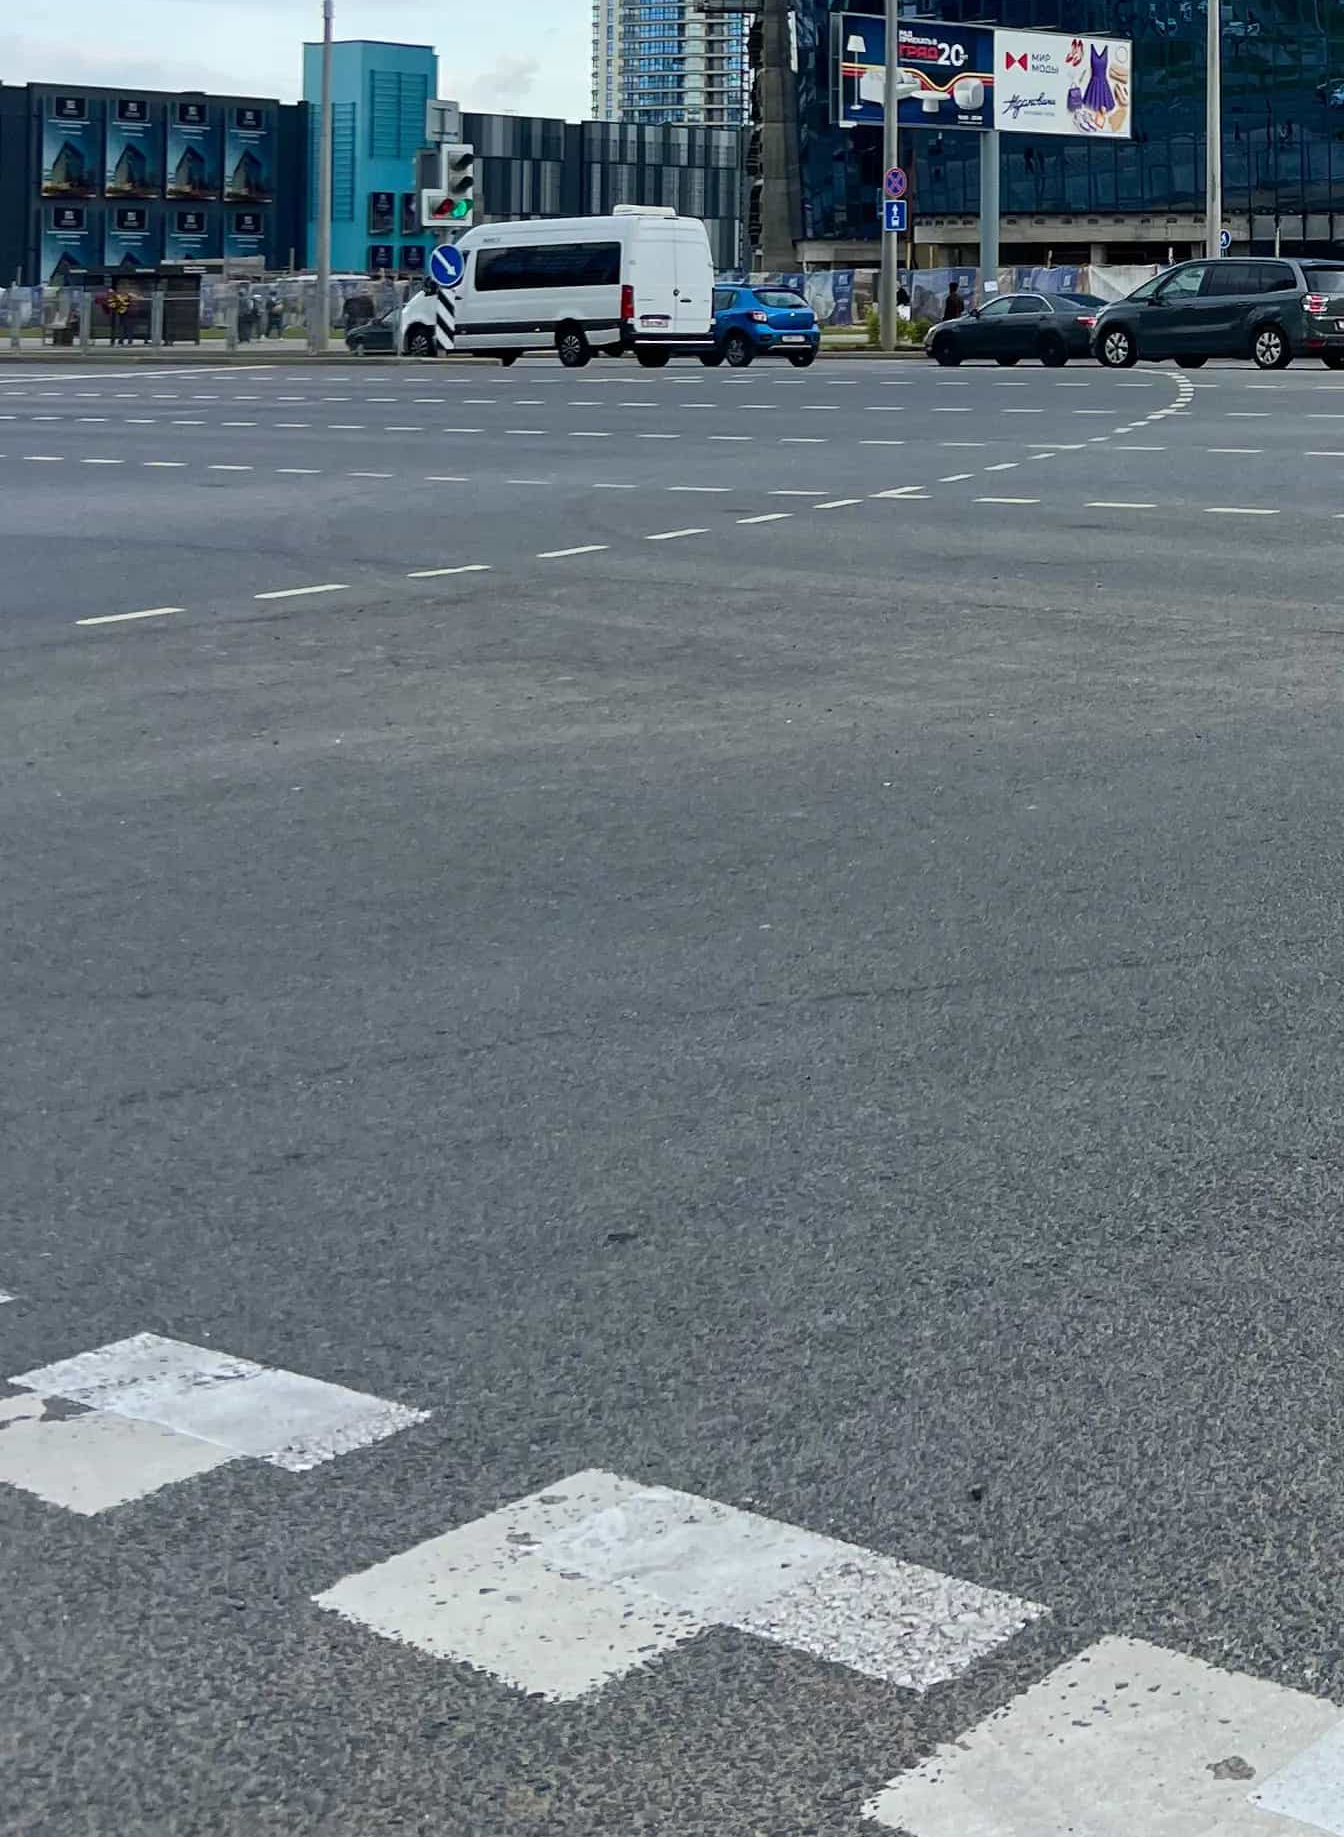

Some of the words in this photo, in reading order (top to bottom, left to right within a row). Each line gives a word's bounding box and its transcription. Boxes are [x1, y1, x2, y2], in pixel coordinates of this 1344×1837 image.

[938, 42, 965, 67] 20
[1031, 52, 1051, 62] МИР
[1031, 64, 1059, 74] МОДЫ
